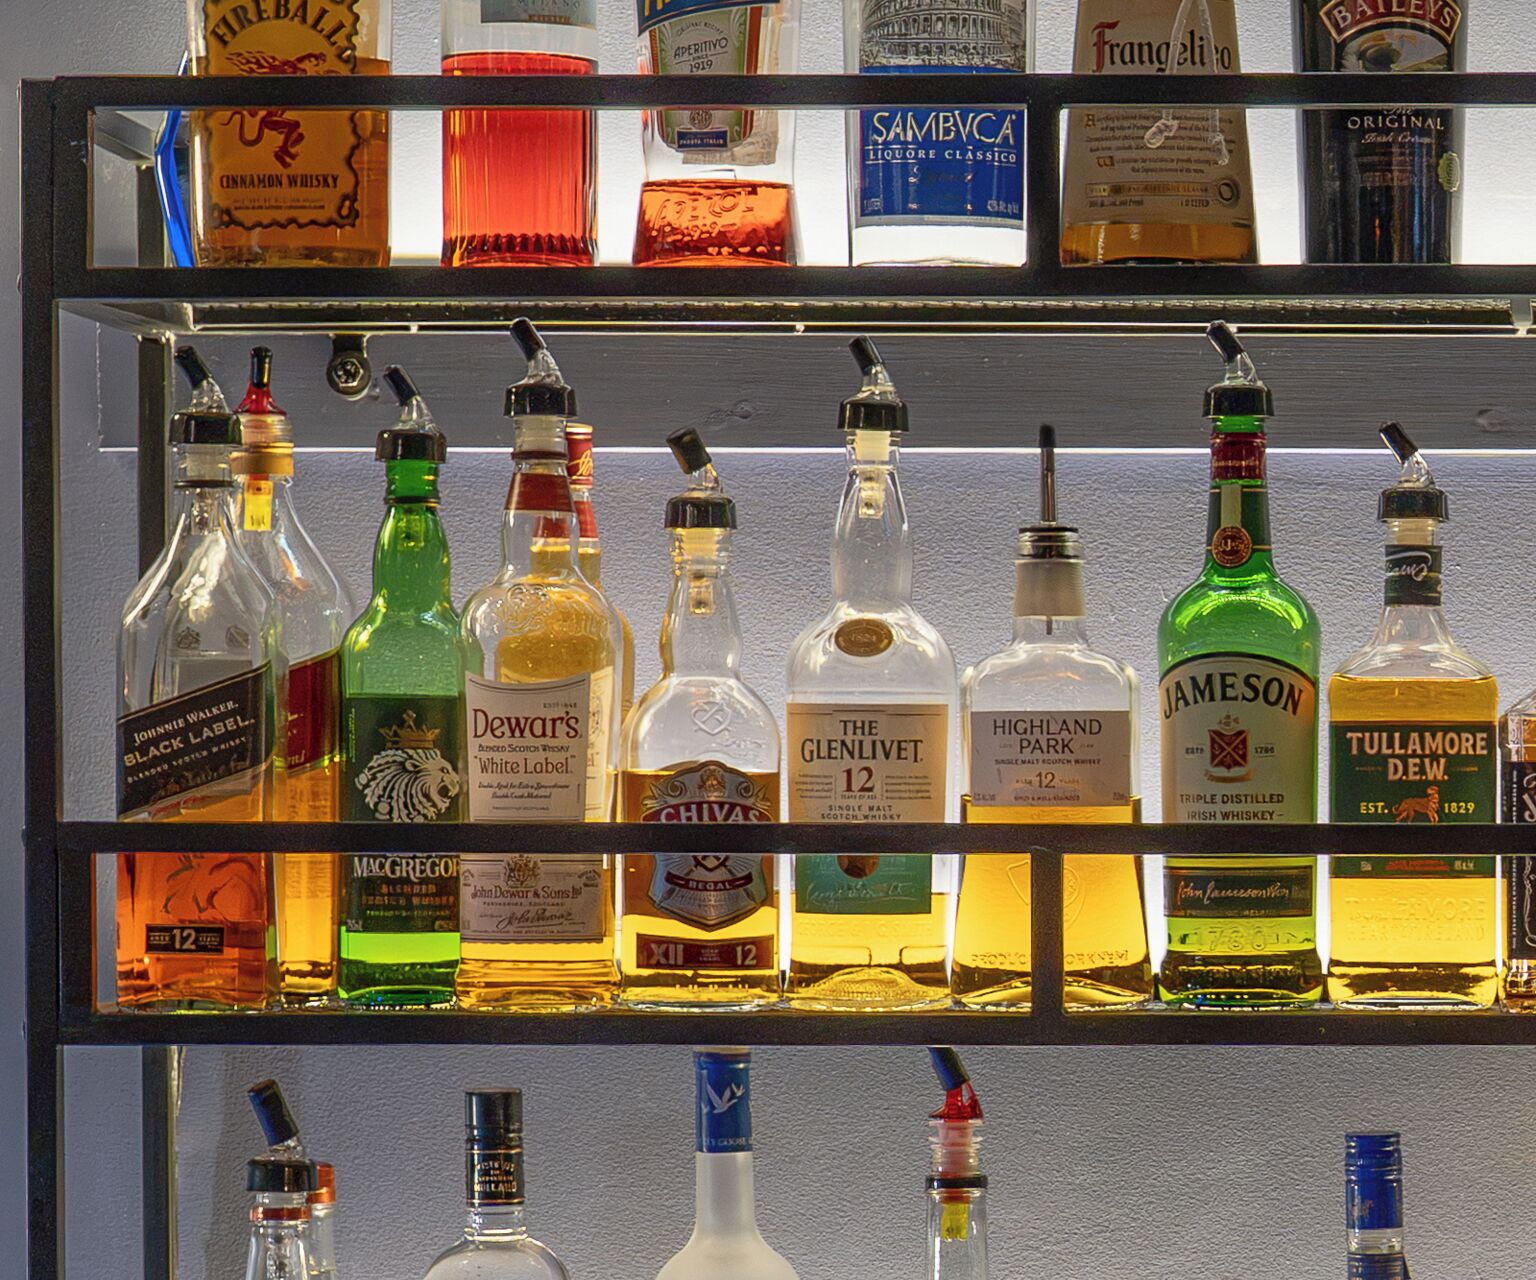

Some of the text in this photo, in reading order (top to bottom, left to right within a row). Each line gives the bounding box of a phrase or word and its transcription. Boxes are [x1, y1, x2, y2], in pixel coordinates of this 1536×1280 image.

[673, 36, 729, 60] APERITIVO
[689, 59, 714, 73] 1919
[1346, 115, 1445, 131] ORIGINAL
[869, 149, 1017, 163] LIQUORE CLASSICO
[219, 172, 341, 190] CINNAMON WHISKY
[1163, 672, 1304, 720] JAMESON
[134, 718, 186, 747] JOHNNIE
[472, 708, 581, 740] Dewar's
[839, 719, 878, 737] THE
[993, 718, 1102, 736] HIGHLAND
[123, 736, 185, 767] BLACK
[507, 743, 540, 753] SCOTCH
[541, 743, 570, 753] WHISKY
[1019, 737, 1075, 755] PARK
[1346, 731, 1488, 755] TULLAMORE
[994, 758, 1020, 766] SINGLE
[1020, 758, 1040, 766] MALT
[1041, 758, 1073, 766] SCOTCH
[1387, 758, 1449, 782] D.E.W.
[841, 766, 875, 793] 12
[1035, 771, 1055, 789] 12
[1180, 793, 1285, 804] TRIPLE DISTILLED
[1359, 801, 1389, 814] EST.
[1443, 801, 1476, 814] 1829
[659, 800, 760, 822] CHIVAS
[820, 812, 902, 821] SCOTCH WHISKY
[828, 804, 893, 813] SINGLE MALT
[1186, 810, 1217, 821] IRISH
[471, 885, 571, 900] John Dewar & Sons
[688, 880, 733, 890] REGAL
[172, 928, 196, 950] 12
[650, 943, 684, 966] XII
[735, 944, 757, 966] 12
